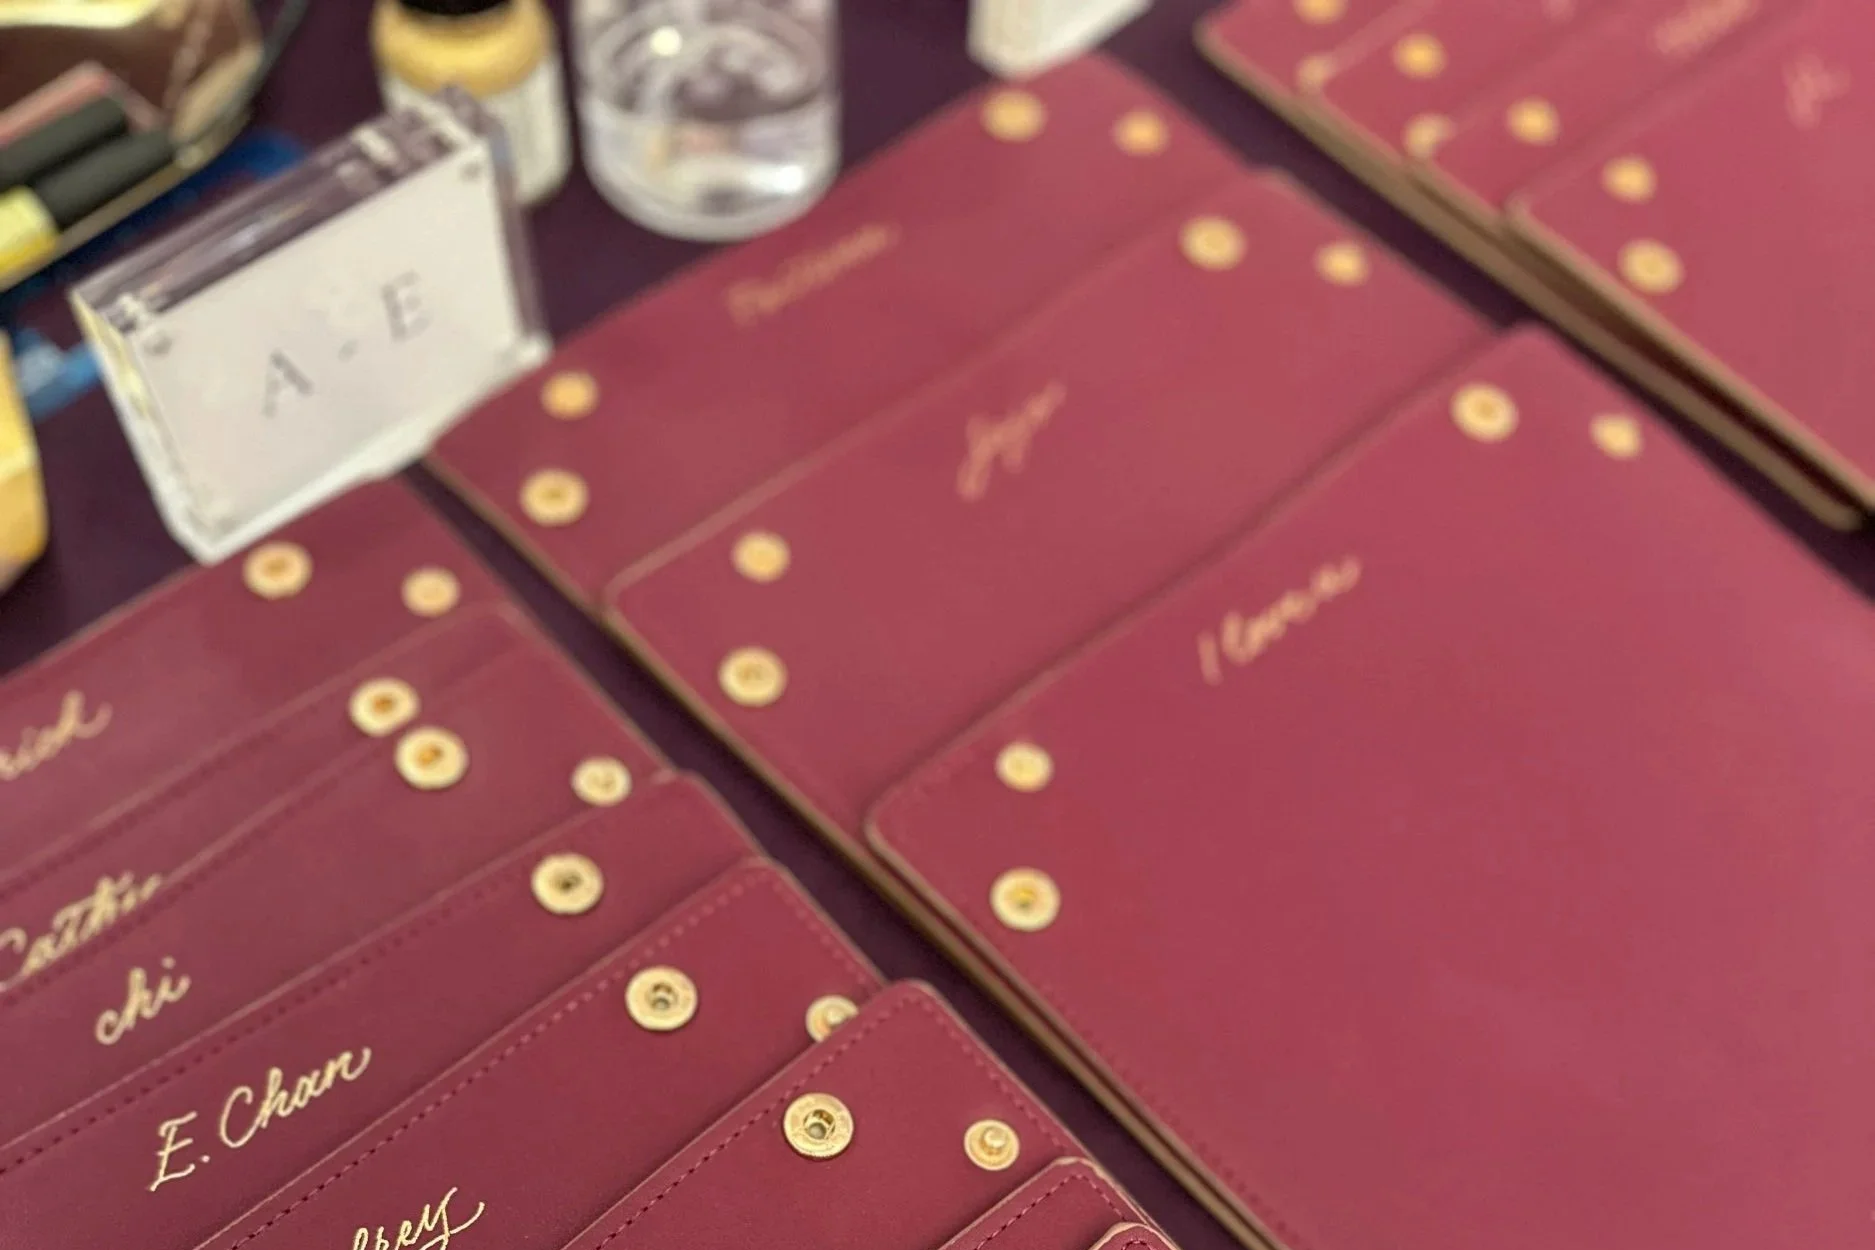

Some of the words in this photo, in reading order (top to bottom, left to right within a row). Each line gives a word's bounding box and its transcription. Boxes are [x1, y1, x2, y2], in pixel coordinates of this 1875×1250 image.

[261, 347, 315, 419] A
[379, 270, 436, 343] E
[148, 1110, 211, 1193] E.
[218, 1046, 373, 1150] Chan
